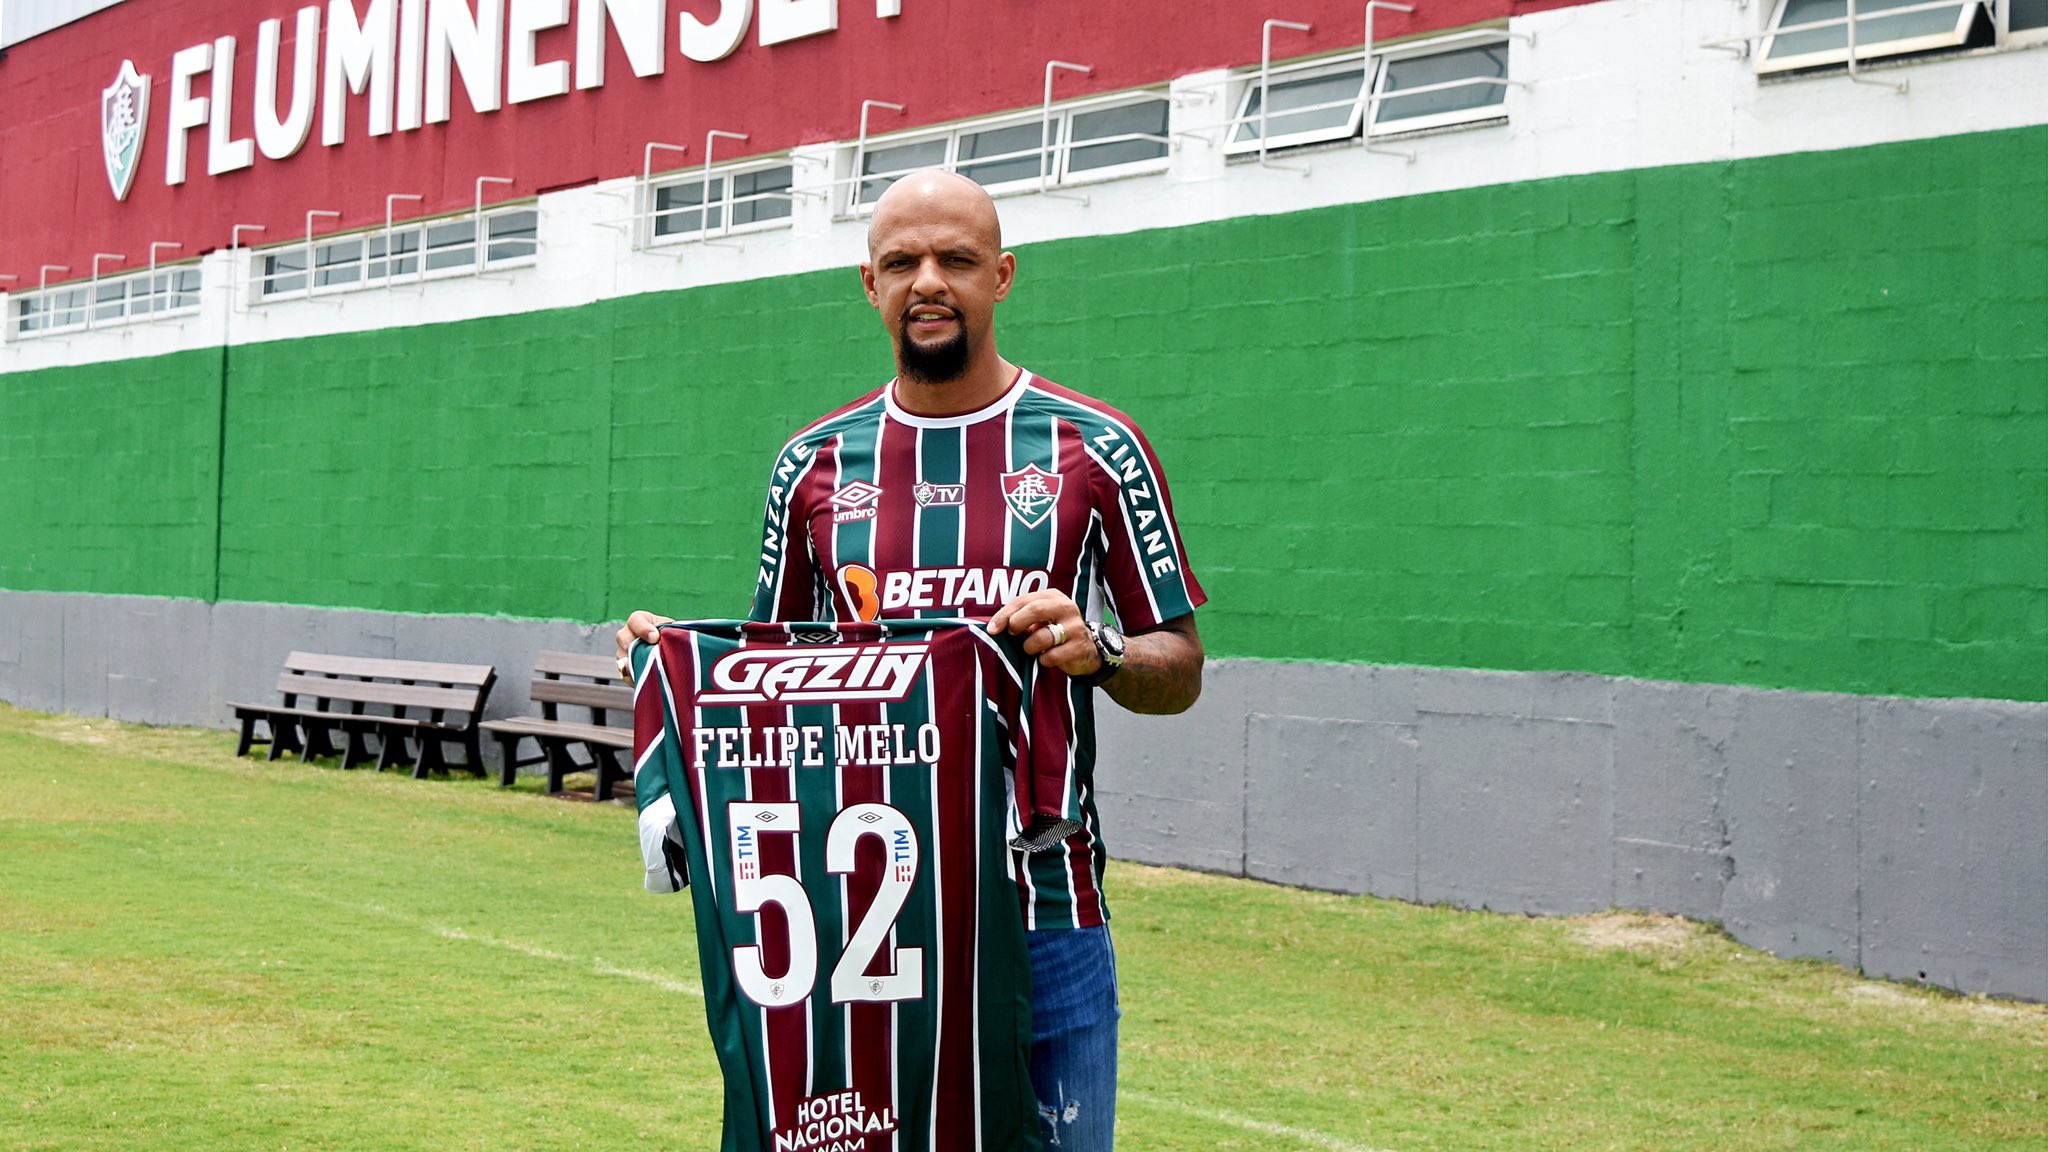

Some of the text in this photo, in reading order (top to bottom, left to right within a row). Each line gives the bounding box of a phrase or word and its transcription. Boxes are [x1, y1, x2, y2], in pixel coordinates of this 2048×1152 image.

[166, 0, 838, 185] FLUMINEN
[758, 441, 812, 589] ZINZANE
[834, 506, 877, 522] umbro
[937, 488, 960, 502] TV
[1093, 426, 1176, 578] ZINZANE
[882, 568, 1049, 610] BETANO
[693, 724, 941, 768] FELIPE MELO
[736, 825, 753, 859] TIM
[893, 829, 910, 862] TIM
[728, 802, 923, 1006] 52
[798, 1091, 866, 1125] HOTEL
[774, 1108, 894, 1152] NACIONAL
